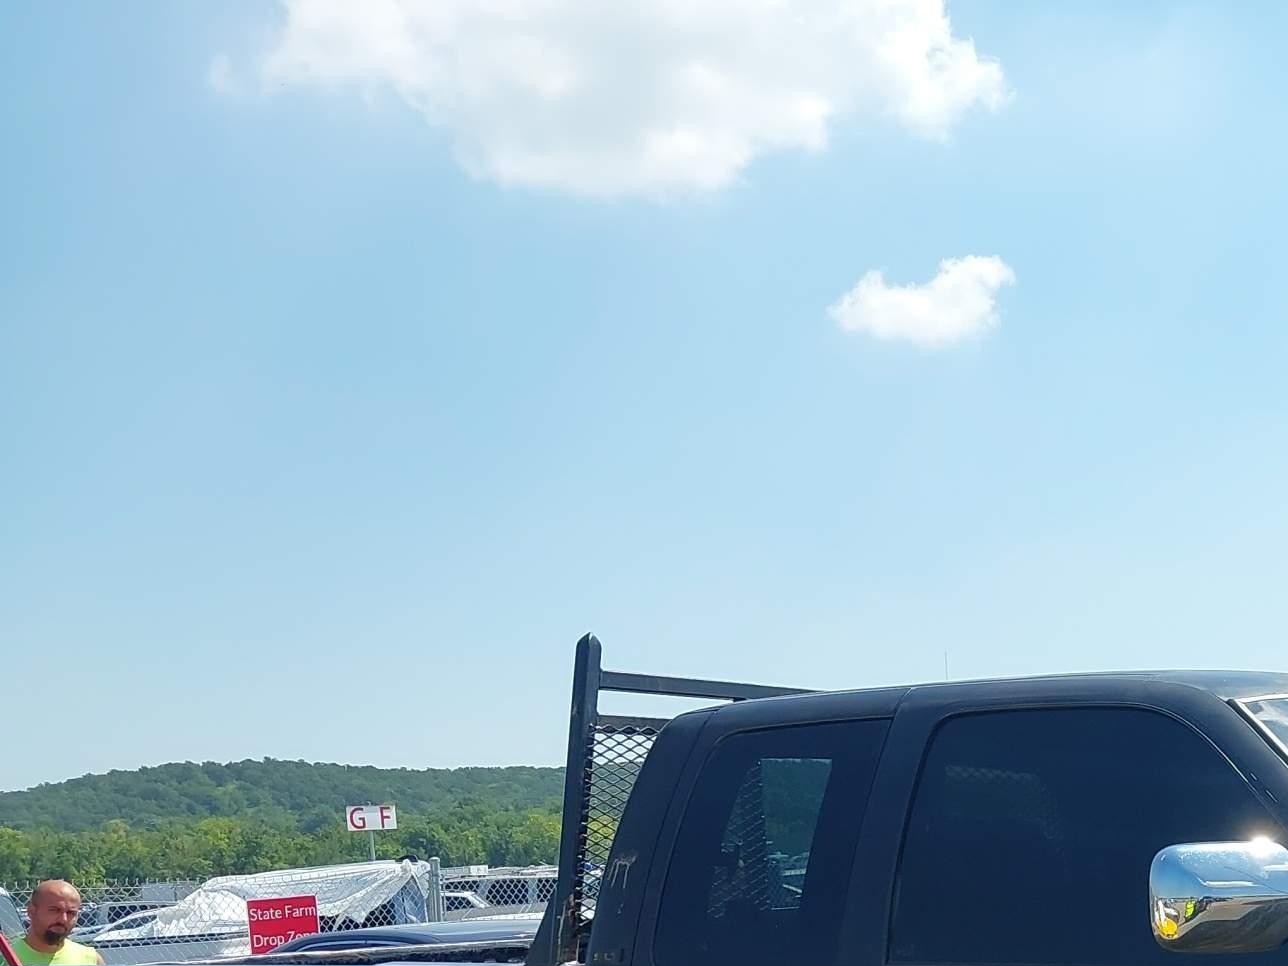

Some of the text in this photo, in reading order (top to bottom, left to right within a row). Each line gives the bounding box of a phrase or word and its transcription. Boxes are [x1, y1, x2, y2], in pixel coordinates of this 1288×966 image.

[349, 806, 391, 829] G F
[250, 905, 316, 921] State Farm
[253, 934, 285, 948] Drop
